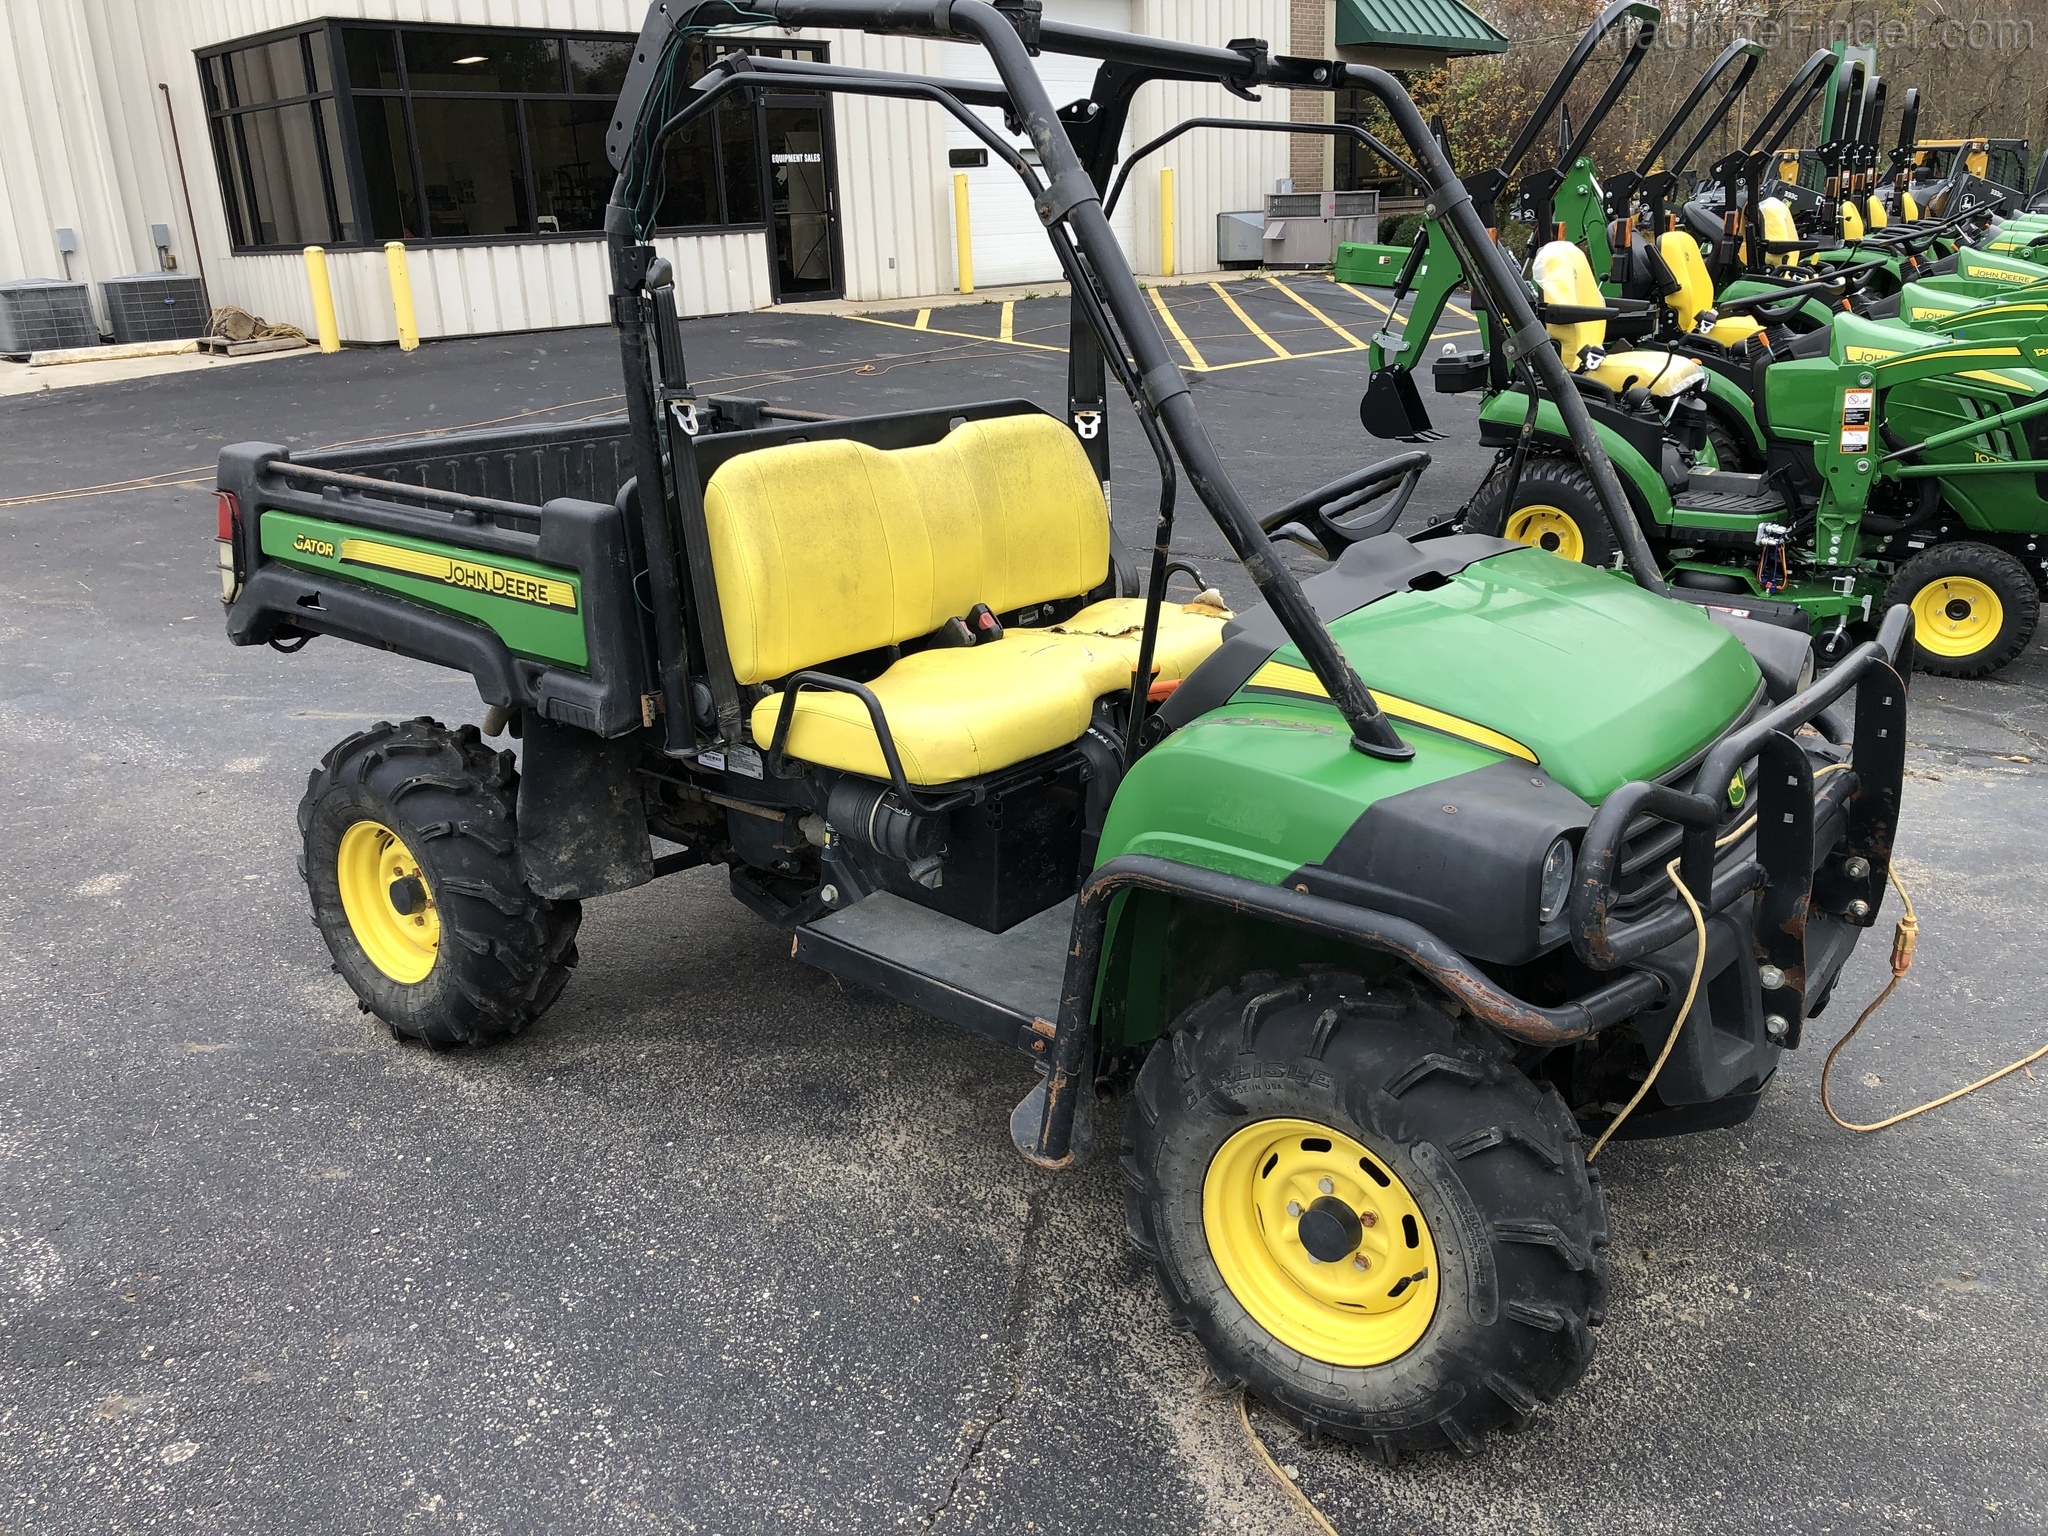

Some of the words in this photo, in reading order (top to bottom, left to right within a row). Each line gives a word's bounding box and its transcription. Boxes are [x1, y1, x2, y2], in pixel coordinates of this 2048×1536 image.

[771, 153, 803, 164] EQUIPMENT
[804, 153, 821, 163] SALES
[1974, 269, 1999, 279] JOHN
[2000, 272, 2031, 284] DEERE
[1920, 311, 1946, 320] JOH
[1855, 351, 1888, 362] JOH
[292, 533, 335, 558] GATOR
[444, 561, 488, 590] JOHN
[492, 570, 550, 603] DEERE
[1184, 1062, 1334, 1112] CARLISLE
[1264, 1083, 1284, 1091] USA
